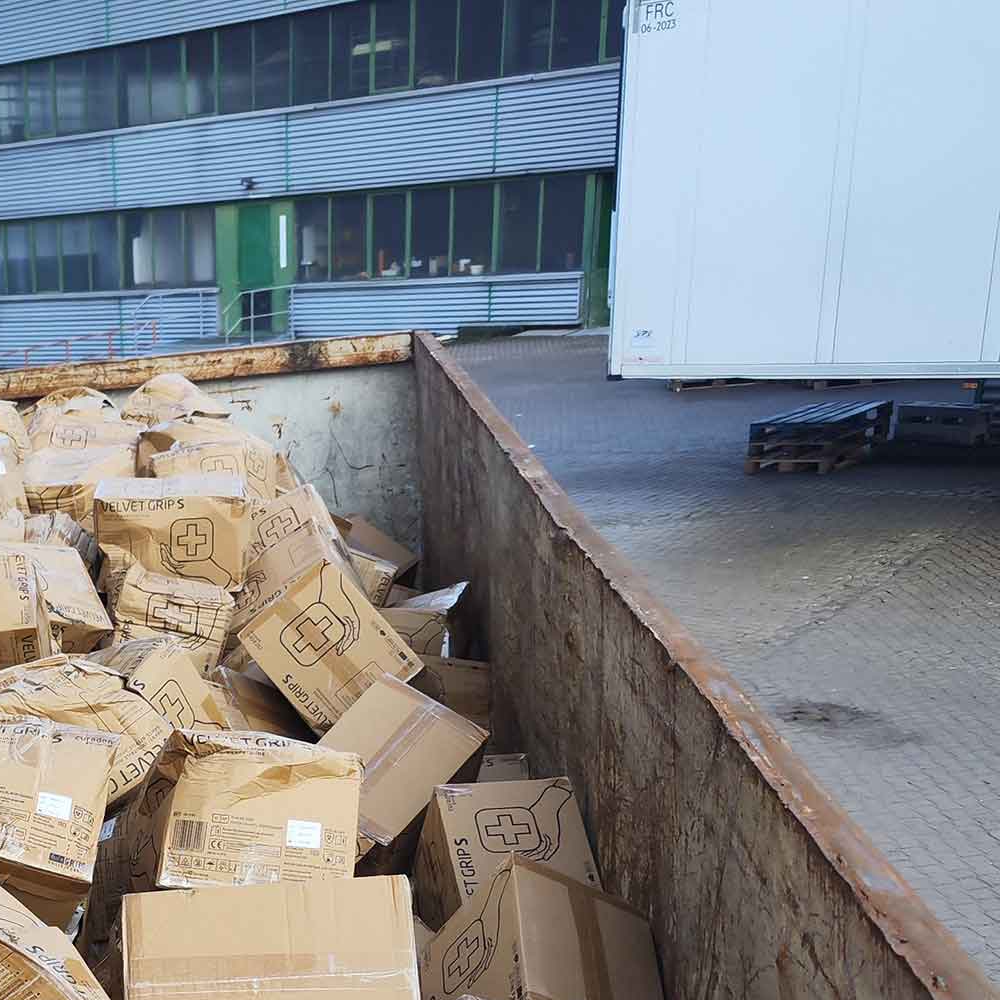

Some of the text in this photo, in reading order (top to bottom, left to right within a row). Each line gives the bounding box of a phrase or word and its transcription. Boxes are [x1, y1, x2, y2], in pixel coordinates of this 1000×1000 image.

[646, 2, 674, 18] FRC
[101, 498, 185, 513] VELVET GRIPS
[460, 836, 470, 881] GRIPS
